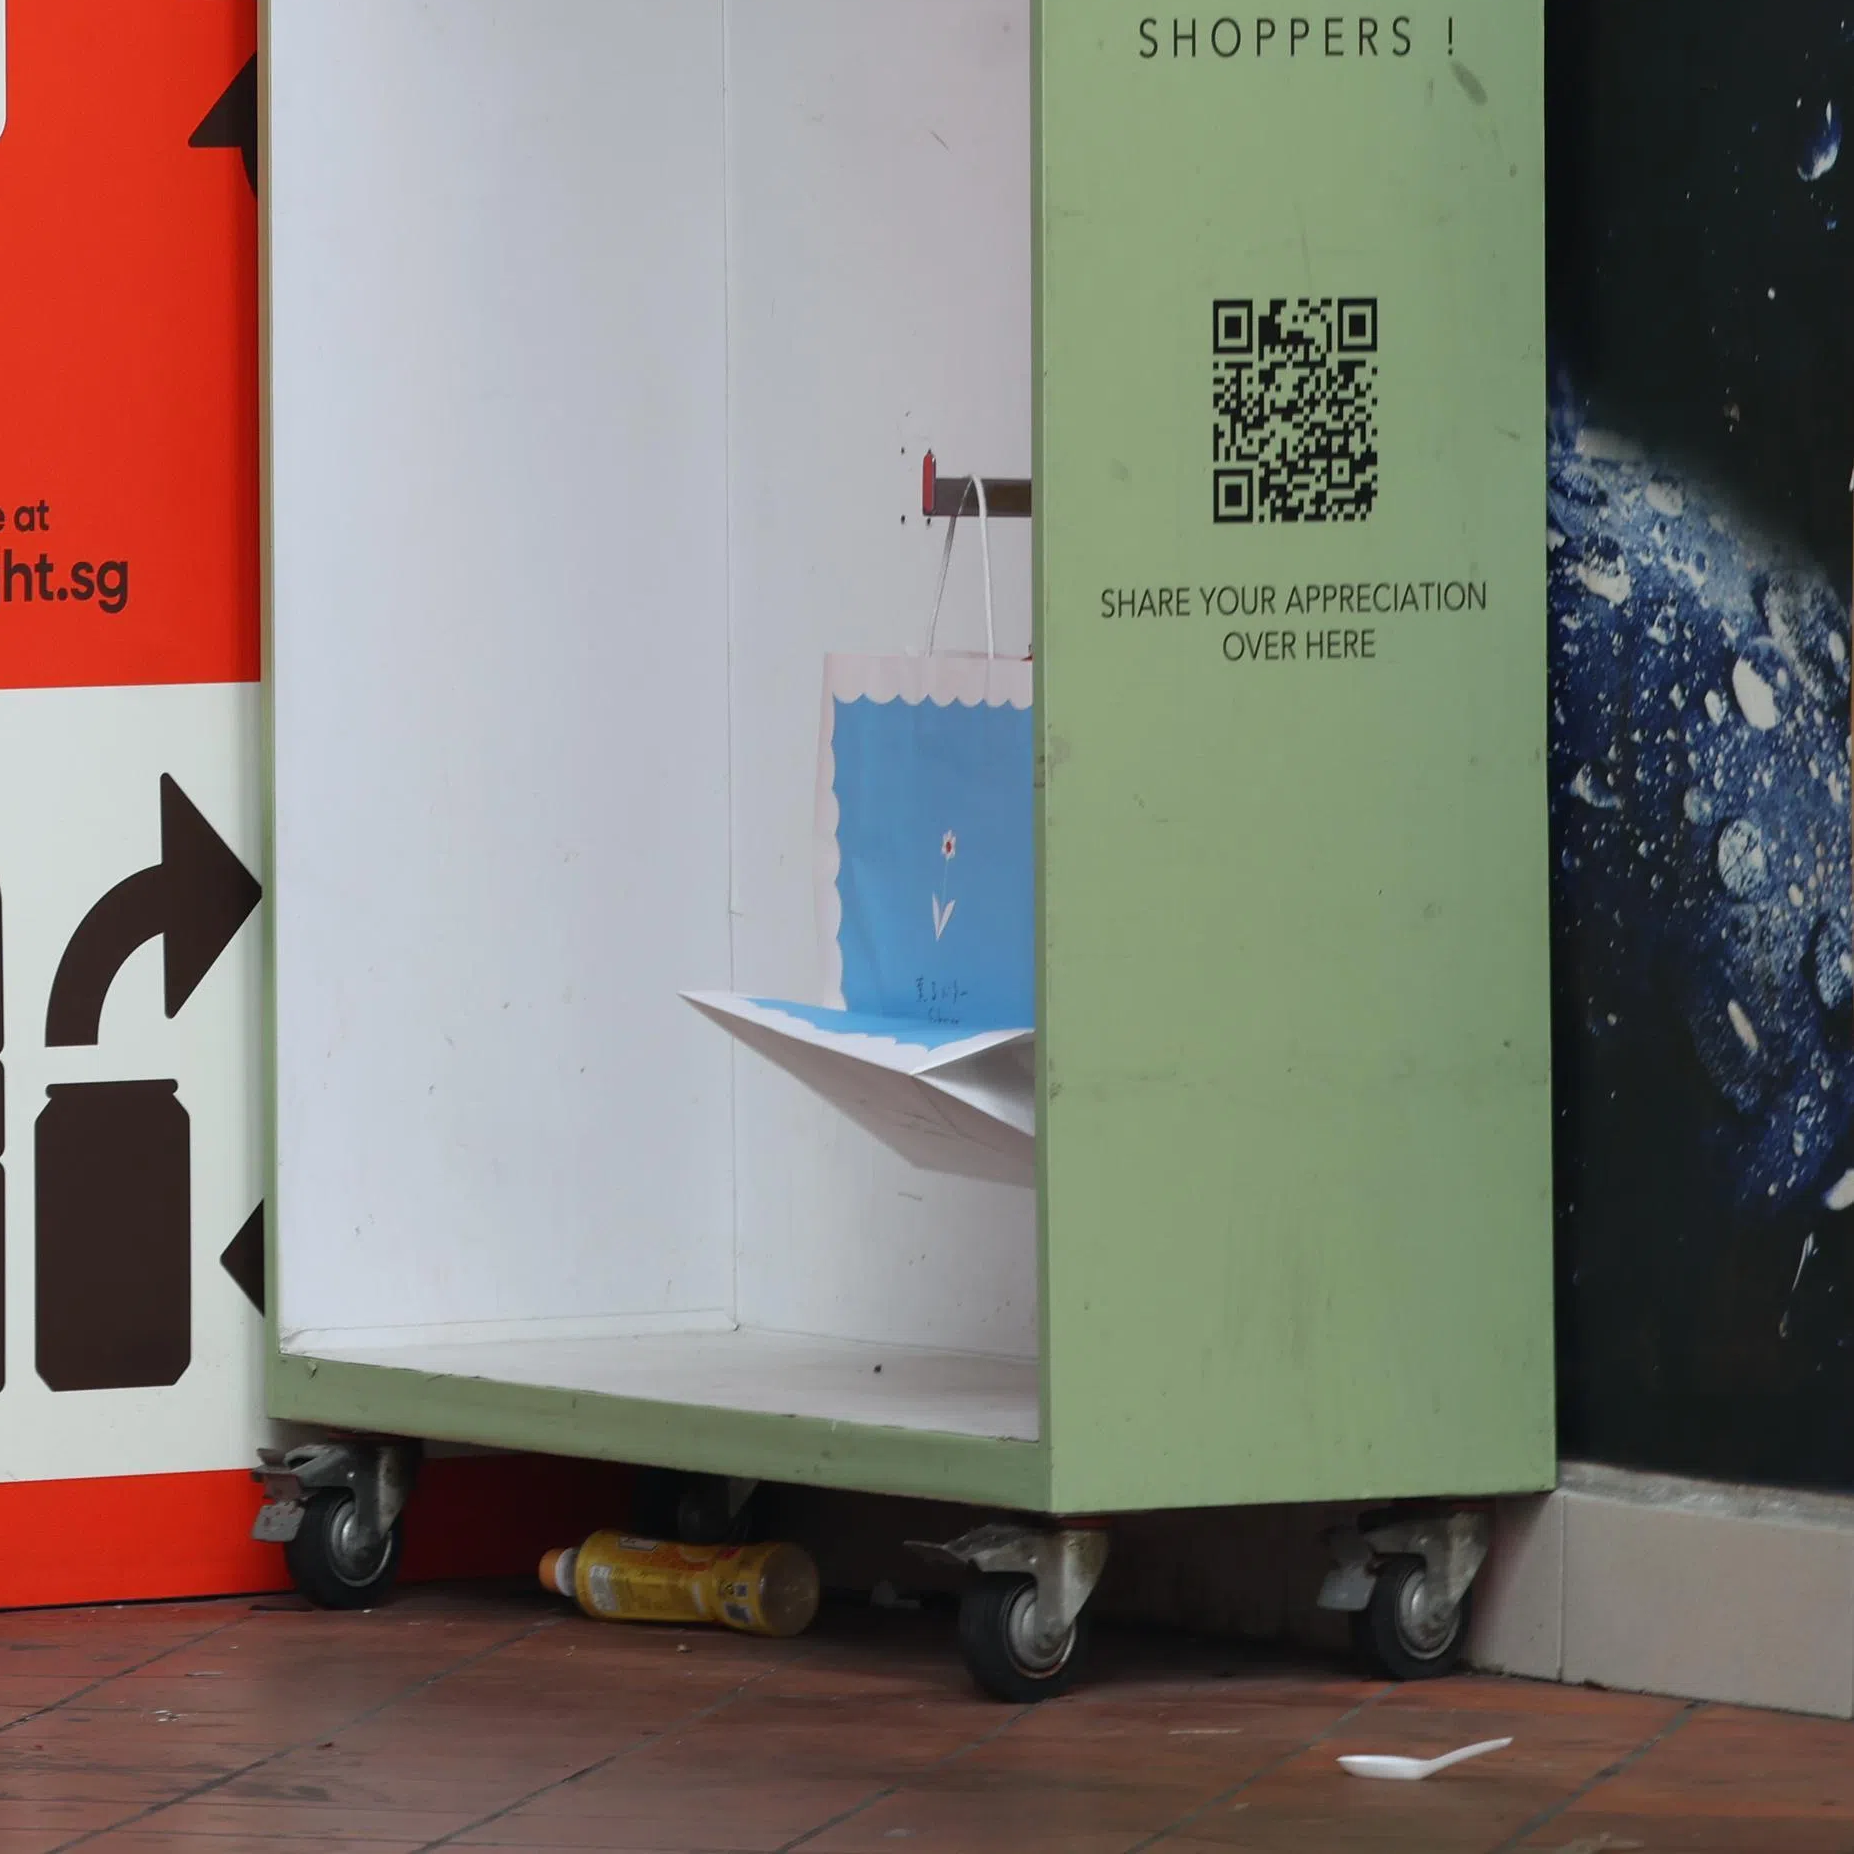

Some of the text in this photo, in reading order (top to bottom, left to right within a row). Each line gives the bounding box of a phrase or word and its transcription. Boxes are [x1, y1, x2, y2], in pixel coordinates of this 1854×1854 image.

[1140, 16, 1452, 58] SHOPPERS !
[14, 500, 49, 532] at
[1102, 582, 1486, 618] SHARE YOUR APPRECIATION
[1223, 629, 1375, 661] OVER HERE
